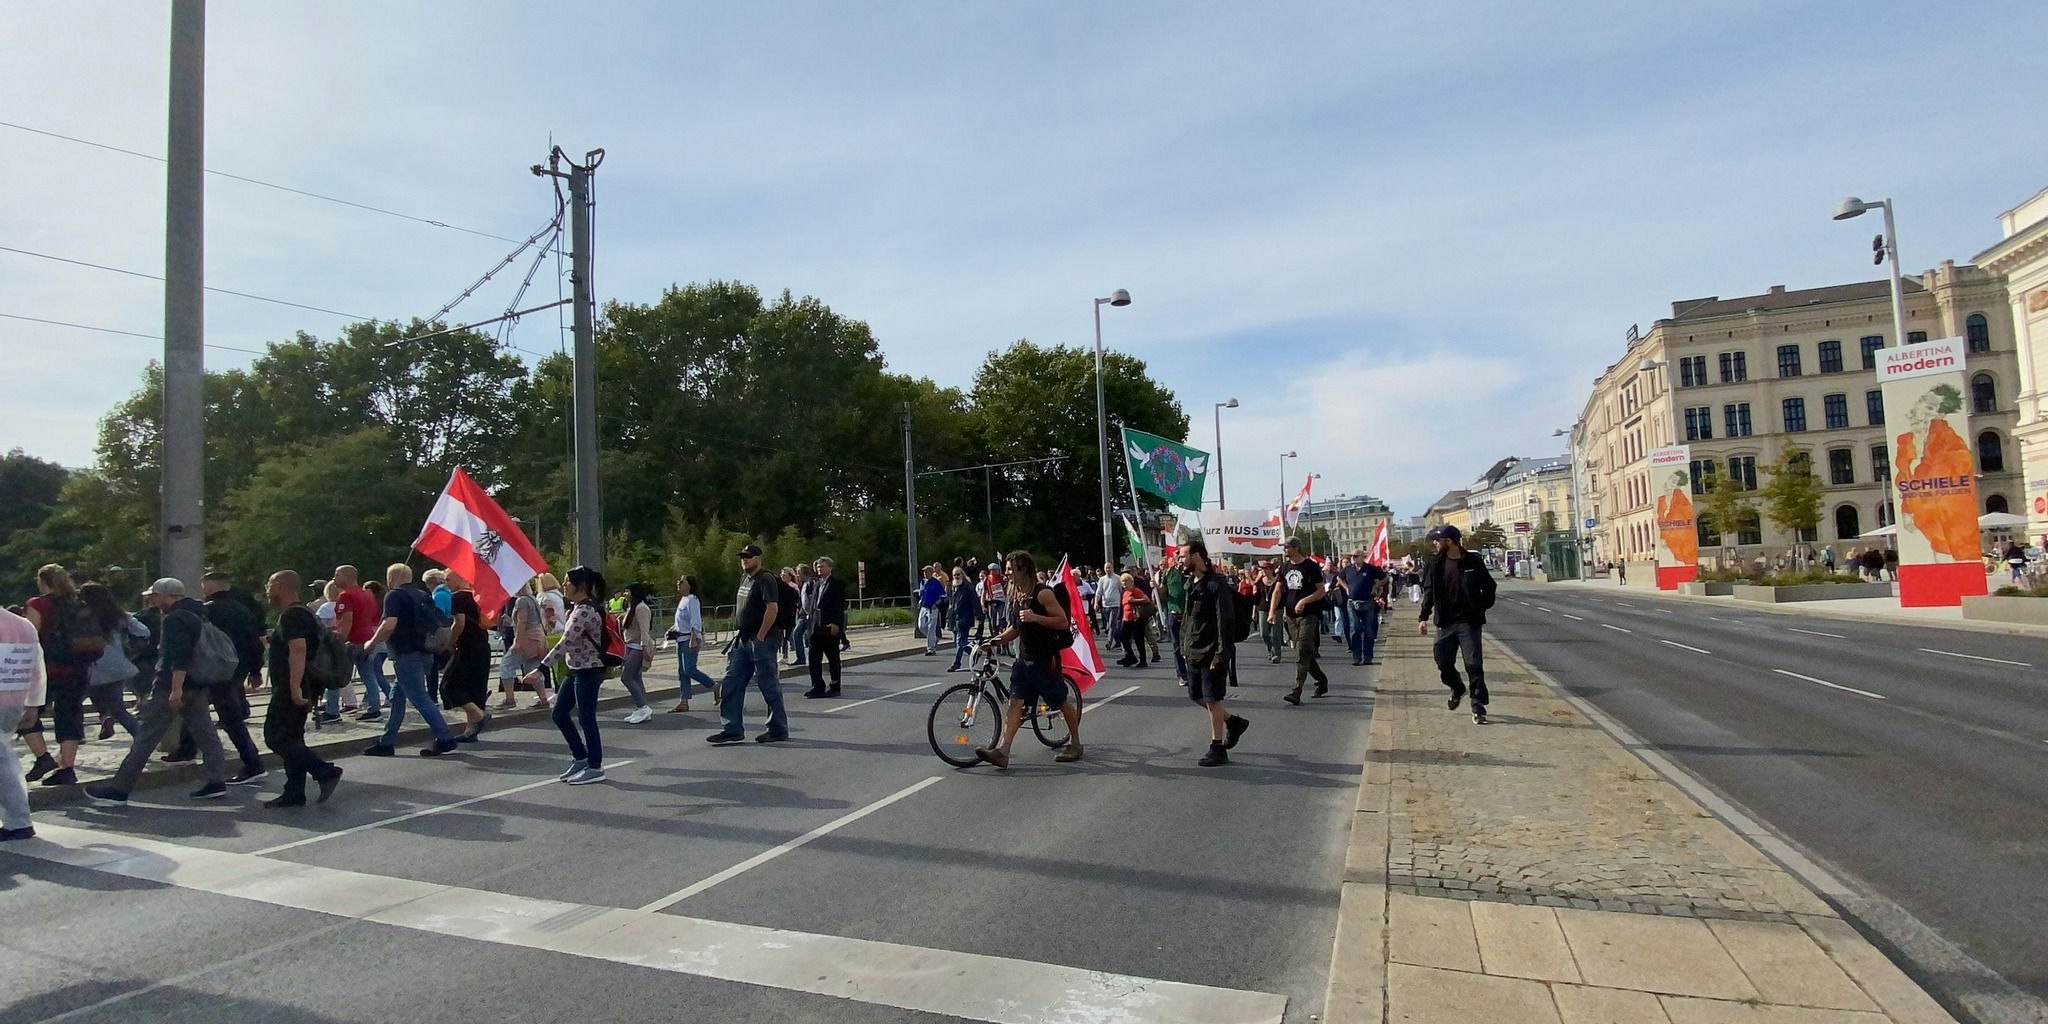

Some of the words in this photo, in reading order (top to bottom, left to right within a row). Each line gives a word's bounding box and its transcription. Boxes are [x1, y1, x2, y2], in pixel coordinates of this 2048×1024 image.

[1887, 345, 1953, 363] ALBERTINA
[1887, 356, 1955, 375] modern
[1652, 455, 1685, 464] modern
[1898, 475, 1970, 492] SCHIELE
[1203, 527, 1221, 535] urz
[1224, 526, 1259, 536] MUSS
